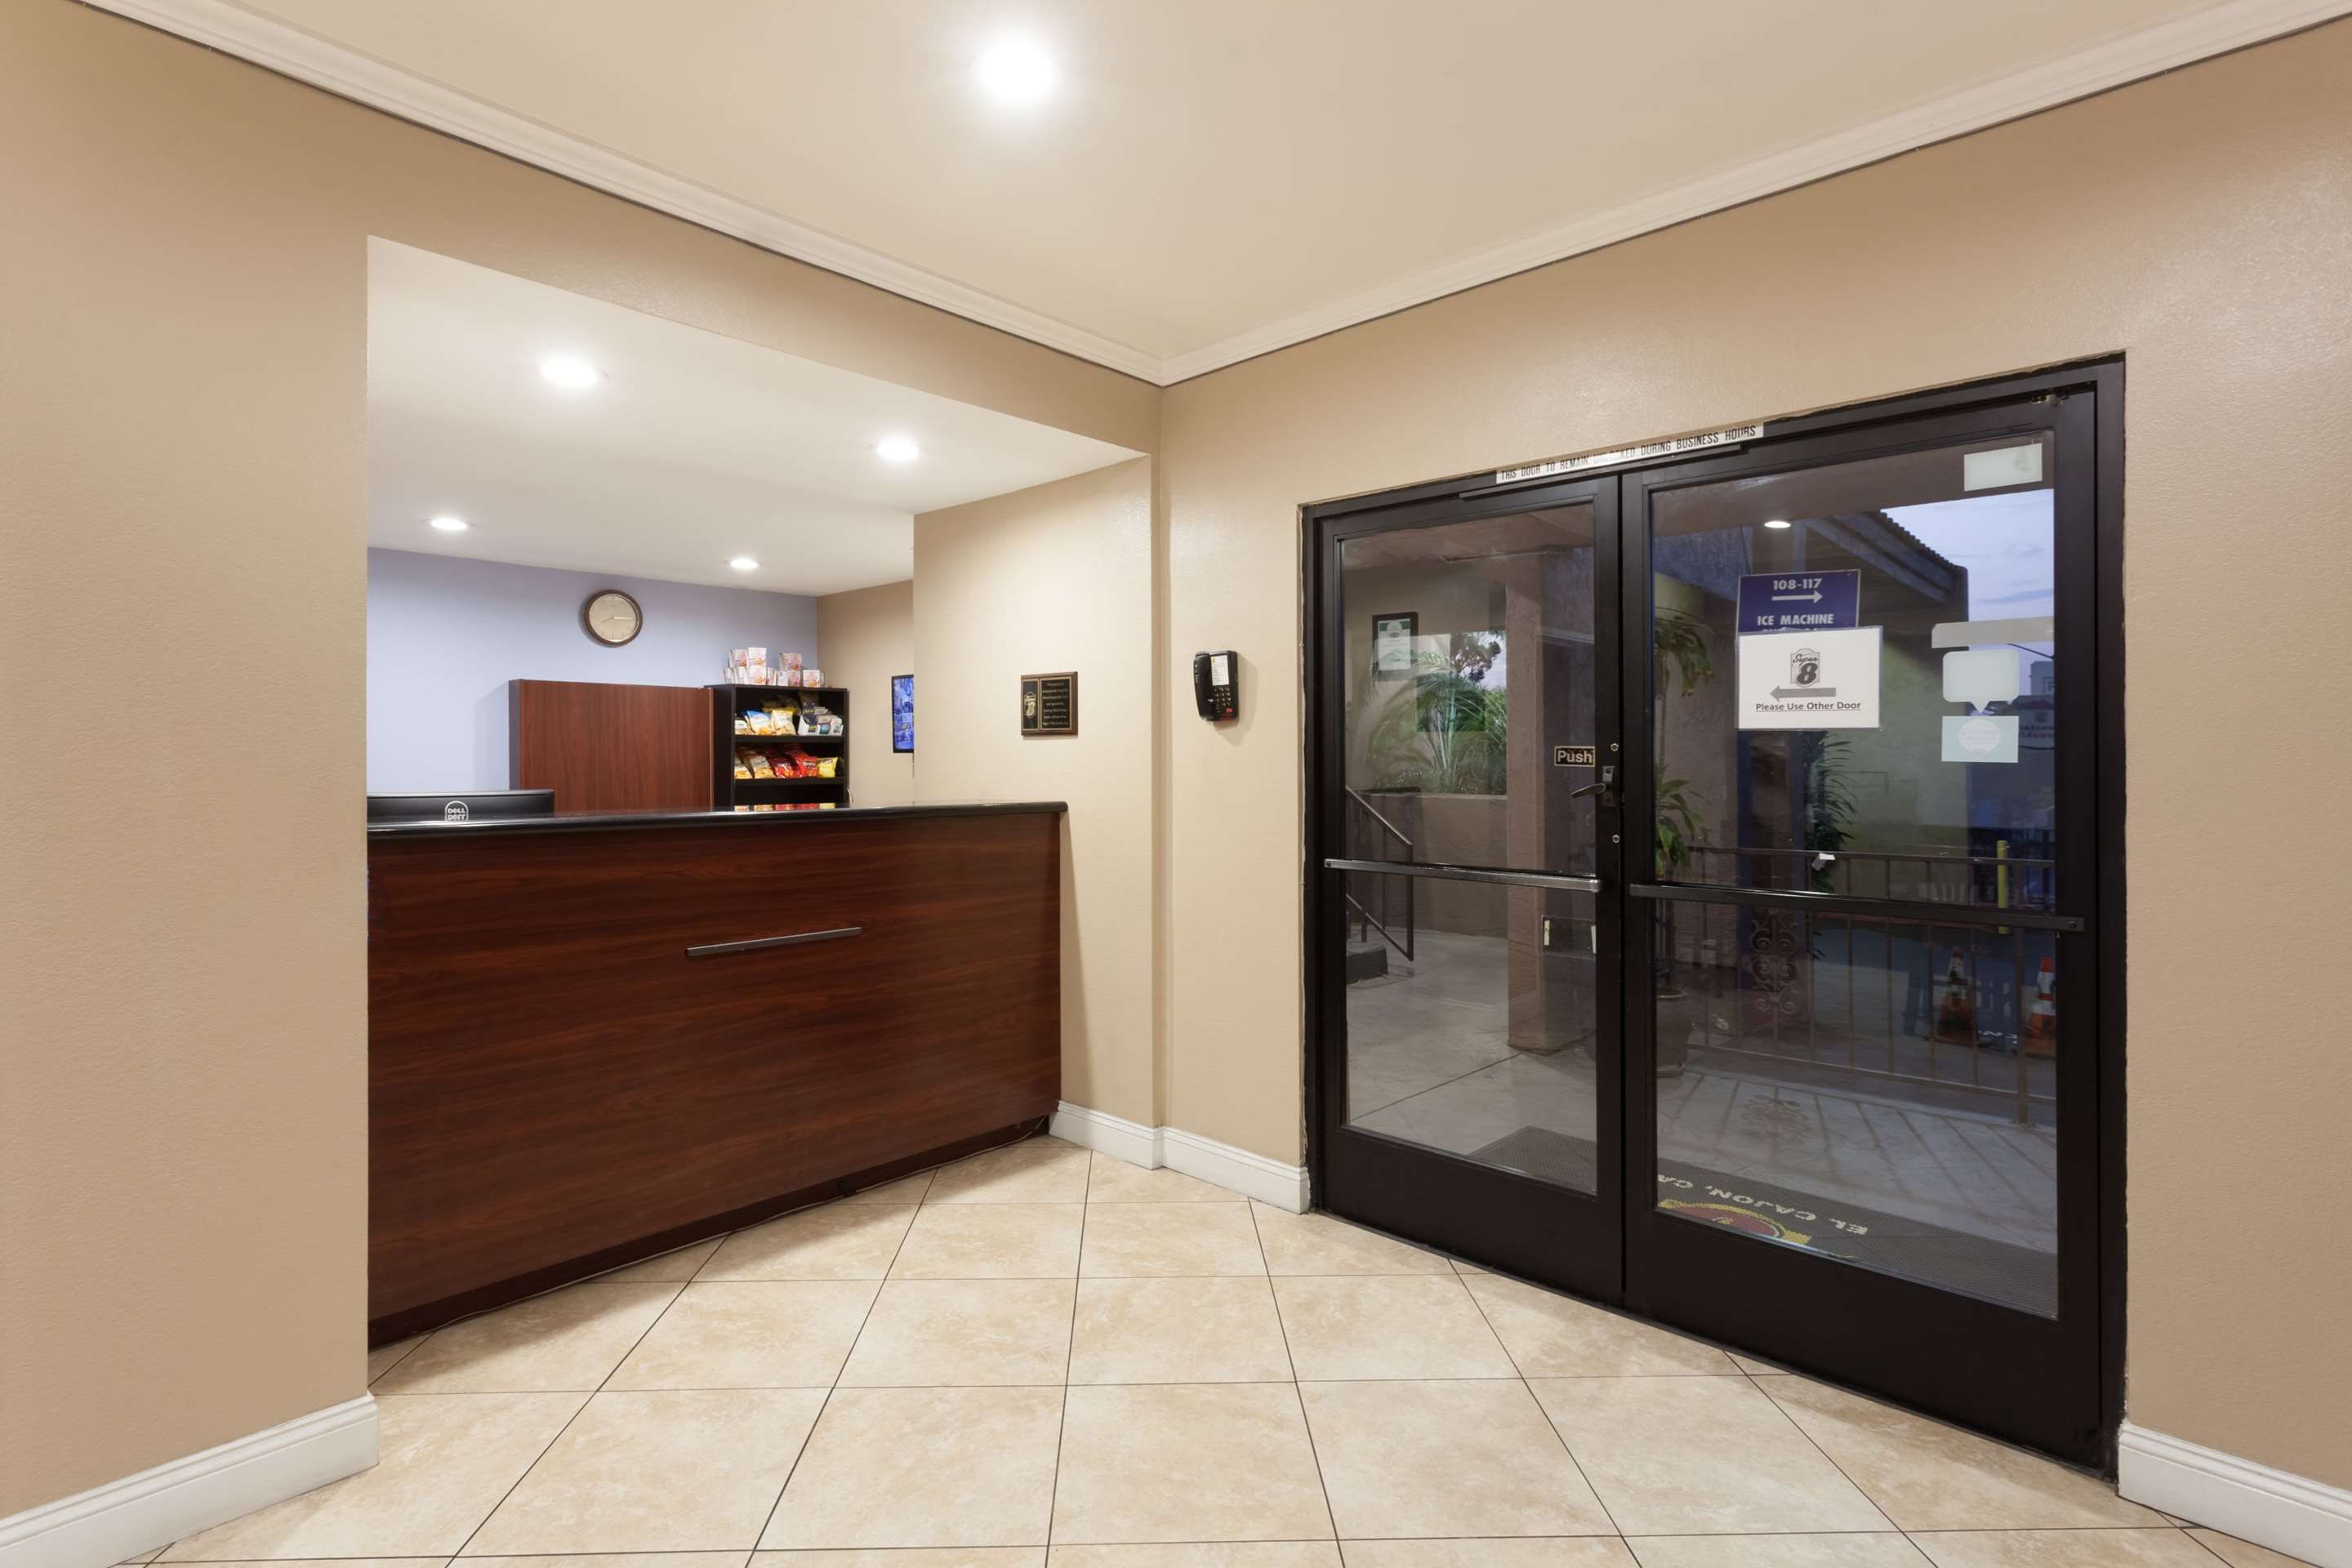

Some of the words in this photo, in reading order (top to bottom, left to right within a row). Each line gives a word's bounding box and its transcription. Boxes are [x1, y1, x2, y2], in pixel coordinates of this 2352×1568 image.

[1501, 469, 1517, 480] THIS
[1521, 464, 1540, 477] DOOR
[1546, 461, 1556, 472] TO
[1560, 455, 1588, 470] REMAIN
[1641, 441, 1672, 456] DURING
[1676, 432, 1719, 449] BUSINESS
[1725, 425, 1756, 441] HOURS
[1773, 578, 1823, 590] 108-117
[1757, 615, 1775, 626] ICE
[1780, 614, 1834, 626] MACHINE
[1797, 662, 1818, 684] 8
[1806, 702, 1833, 710] Other
[1557, 750, 1593, 763] Push
[1658, 1174, 1694, 1188] CA
[1705, 1185, 1817, 1221] CAJON,
[1829, 1218, 1868, 1236] EL
